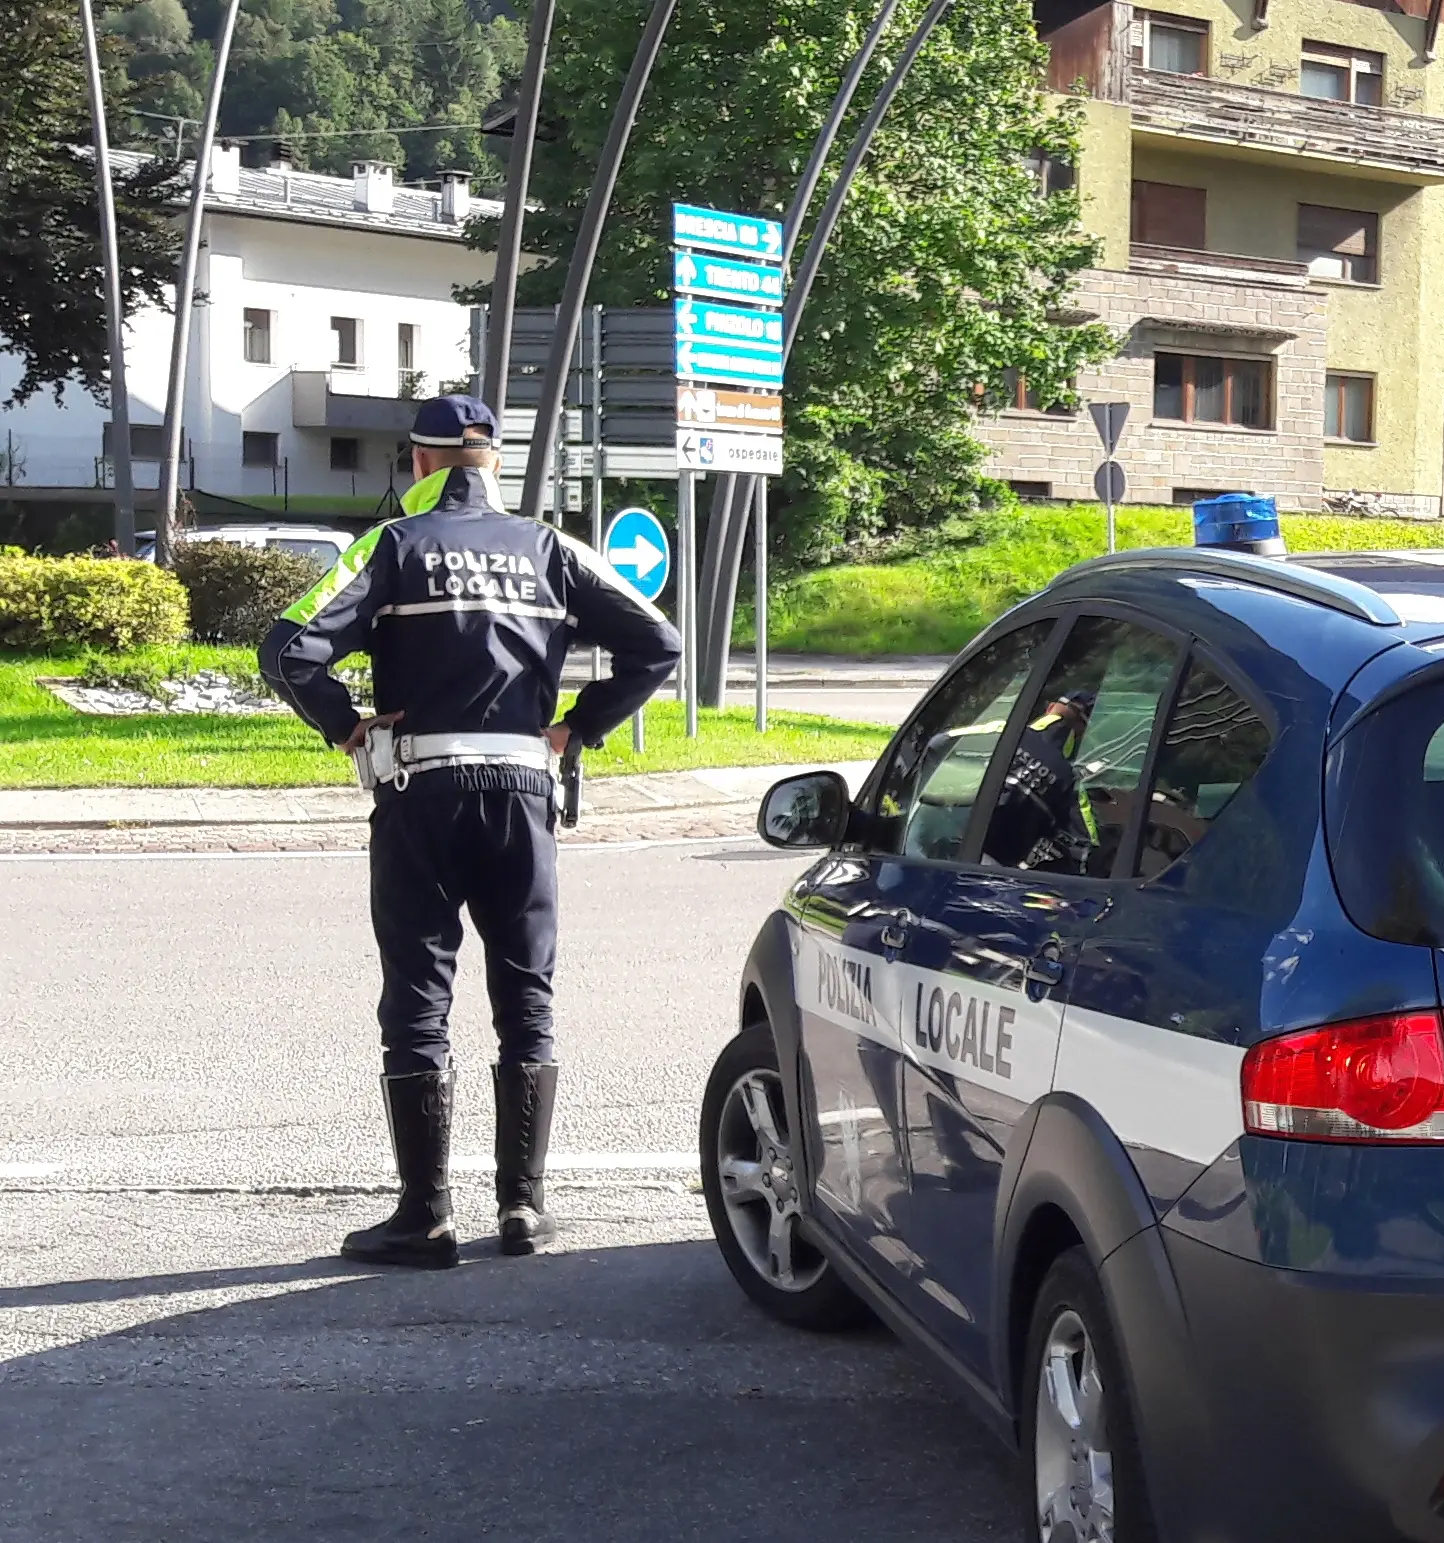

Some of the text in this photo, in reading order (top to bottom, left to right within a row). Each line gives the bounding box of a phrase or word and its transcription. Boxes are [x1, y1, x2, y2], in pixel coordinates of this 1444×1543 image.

[728, 448, 779, 461] ospedale
[425, 549, 536, 576] POLIZIA
[427, 574, 536, 600] LOCALE
[818, 950, 876, 1028] POLIZIA
[916, 982, 1016, 1079] LOCALE
